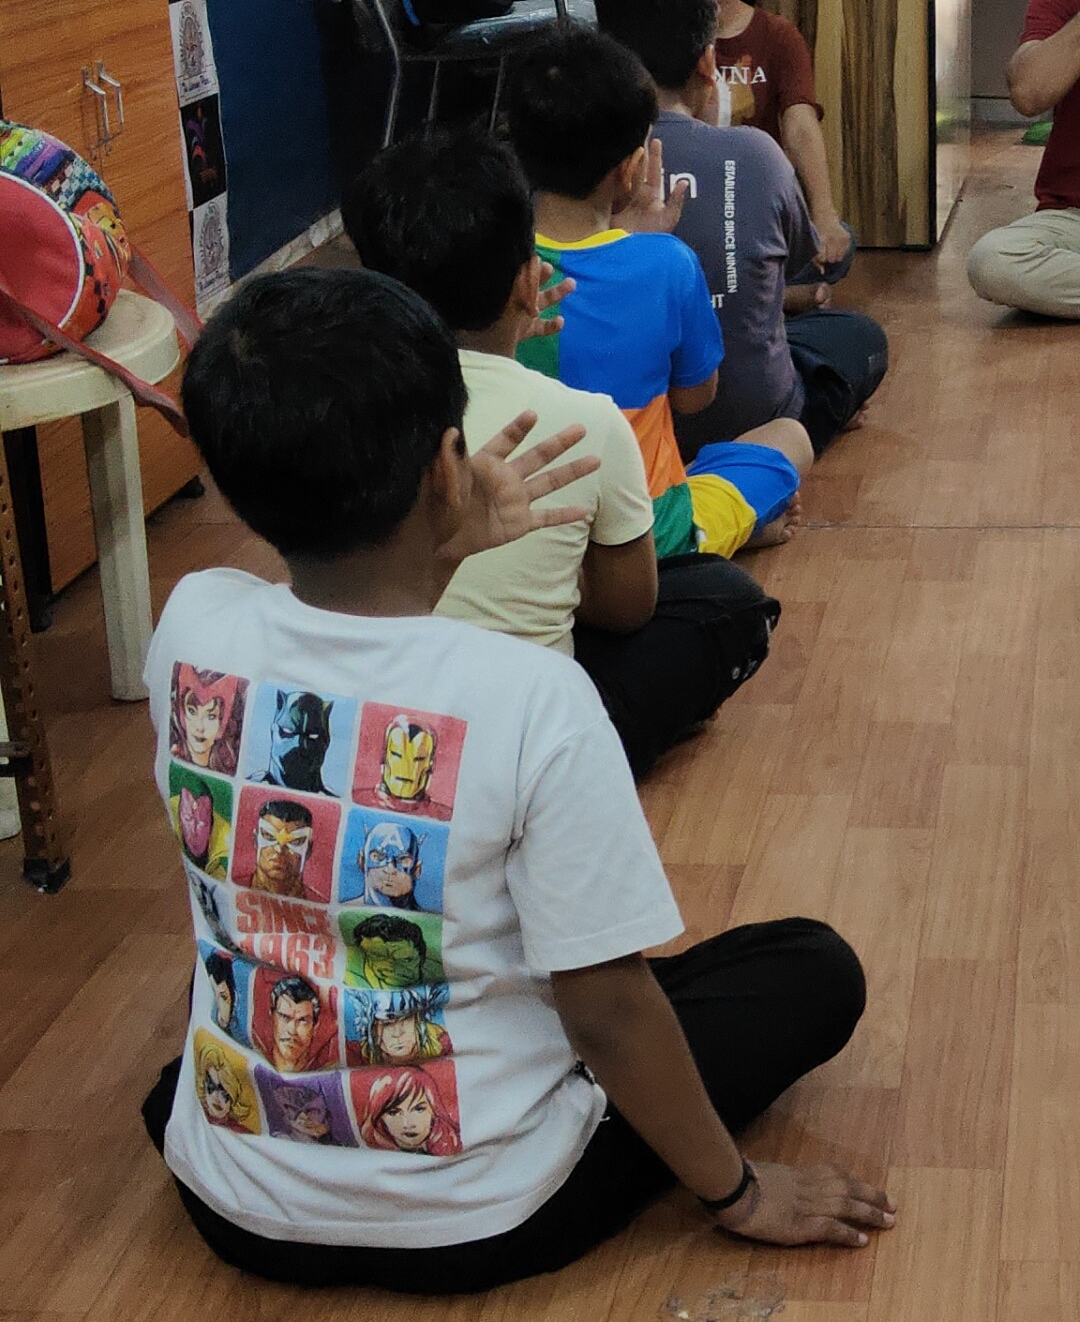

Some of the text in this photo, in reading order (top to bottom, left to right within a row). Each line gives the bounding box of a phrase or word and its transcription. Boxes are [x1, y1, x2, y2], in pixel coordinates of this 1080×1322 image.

[714, 66, 767, 84] NNA
[724, 160, 738, 293] ESTABLISHED SINCE NINTEEN
[241, 932, 336, 980] 1963
